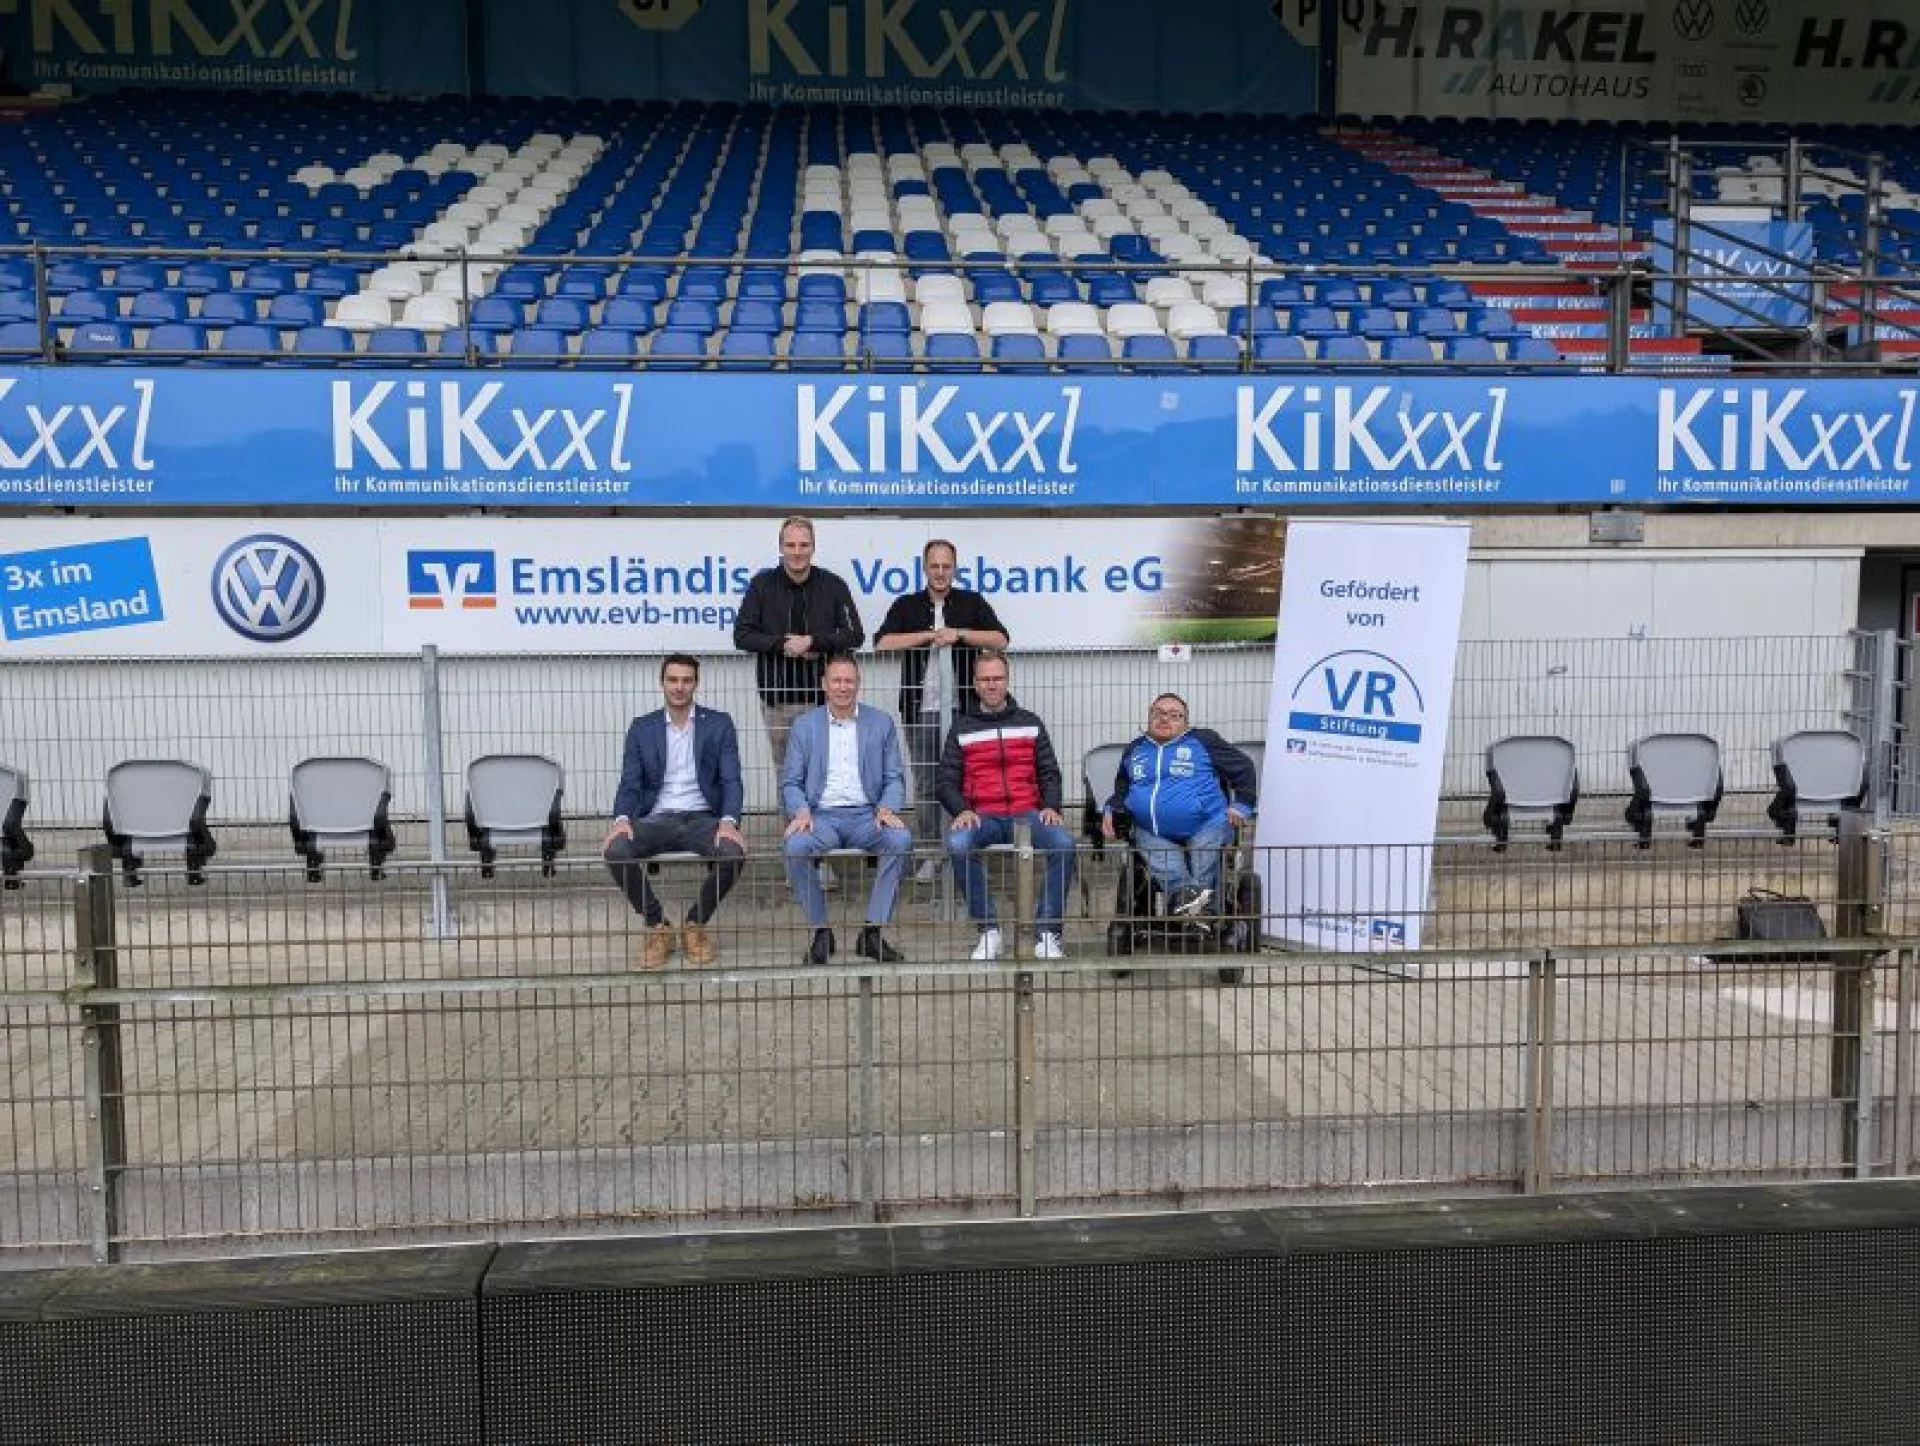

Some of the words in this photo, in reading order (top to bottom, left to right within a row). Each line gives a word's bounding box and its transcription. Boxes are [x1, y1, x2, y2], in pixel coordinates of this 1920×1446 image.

[1488, 72, 1651, 98] AUTOHAUS
[332, 379, 634, 472] KiKxxl
[797, 384, 1082, 473] KiKxxl
[1236, 385, 1508, 472] KiKxxl
[1658, 388, 1918, 472] KiKxxl
[335, 475, 360, 493] Ihr
[366, 475, 631, 493] Kommunikationsdienstleister
[800, 478, 821, 495] Ihr
[828, 478, 1077, 495] Kommunikationsdienstleister
[1236, 476, 1258, 493] Ihr
[1263, 476, 1501, 493] Kommunikationsdienstleister
[1658, 476, 1679, 493] Ihr
[1683, 476, 1909, 493] Kommunikationsdienstleister
[4, 564, 46, 592] 3x
[49, 559, 93, 585] im
[511, 555, 760, 596] Emsländis
[850, 555, 1089, 595] Volsbank
[1103, 555, 1164, 593] eG
[1320, 579, 1421, 602] Gefördert
[12, 588, 151, 631] Emsland
[515, 599, 738, 631] www.evb-mep
[1346, 611, 1385, 627] von
[1324, 667, 1397, 717] VR
[1319, 715, 1389, 739] Stiftung
